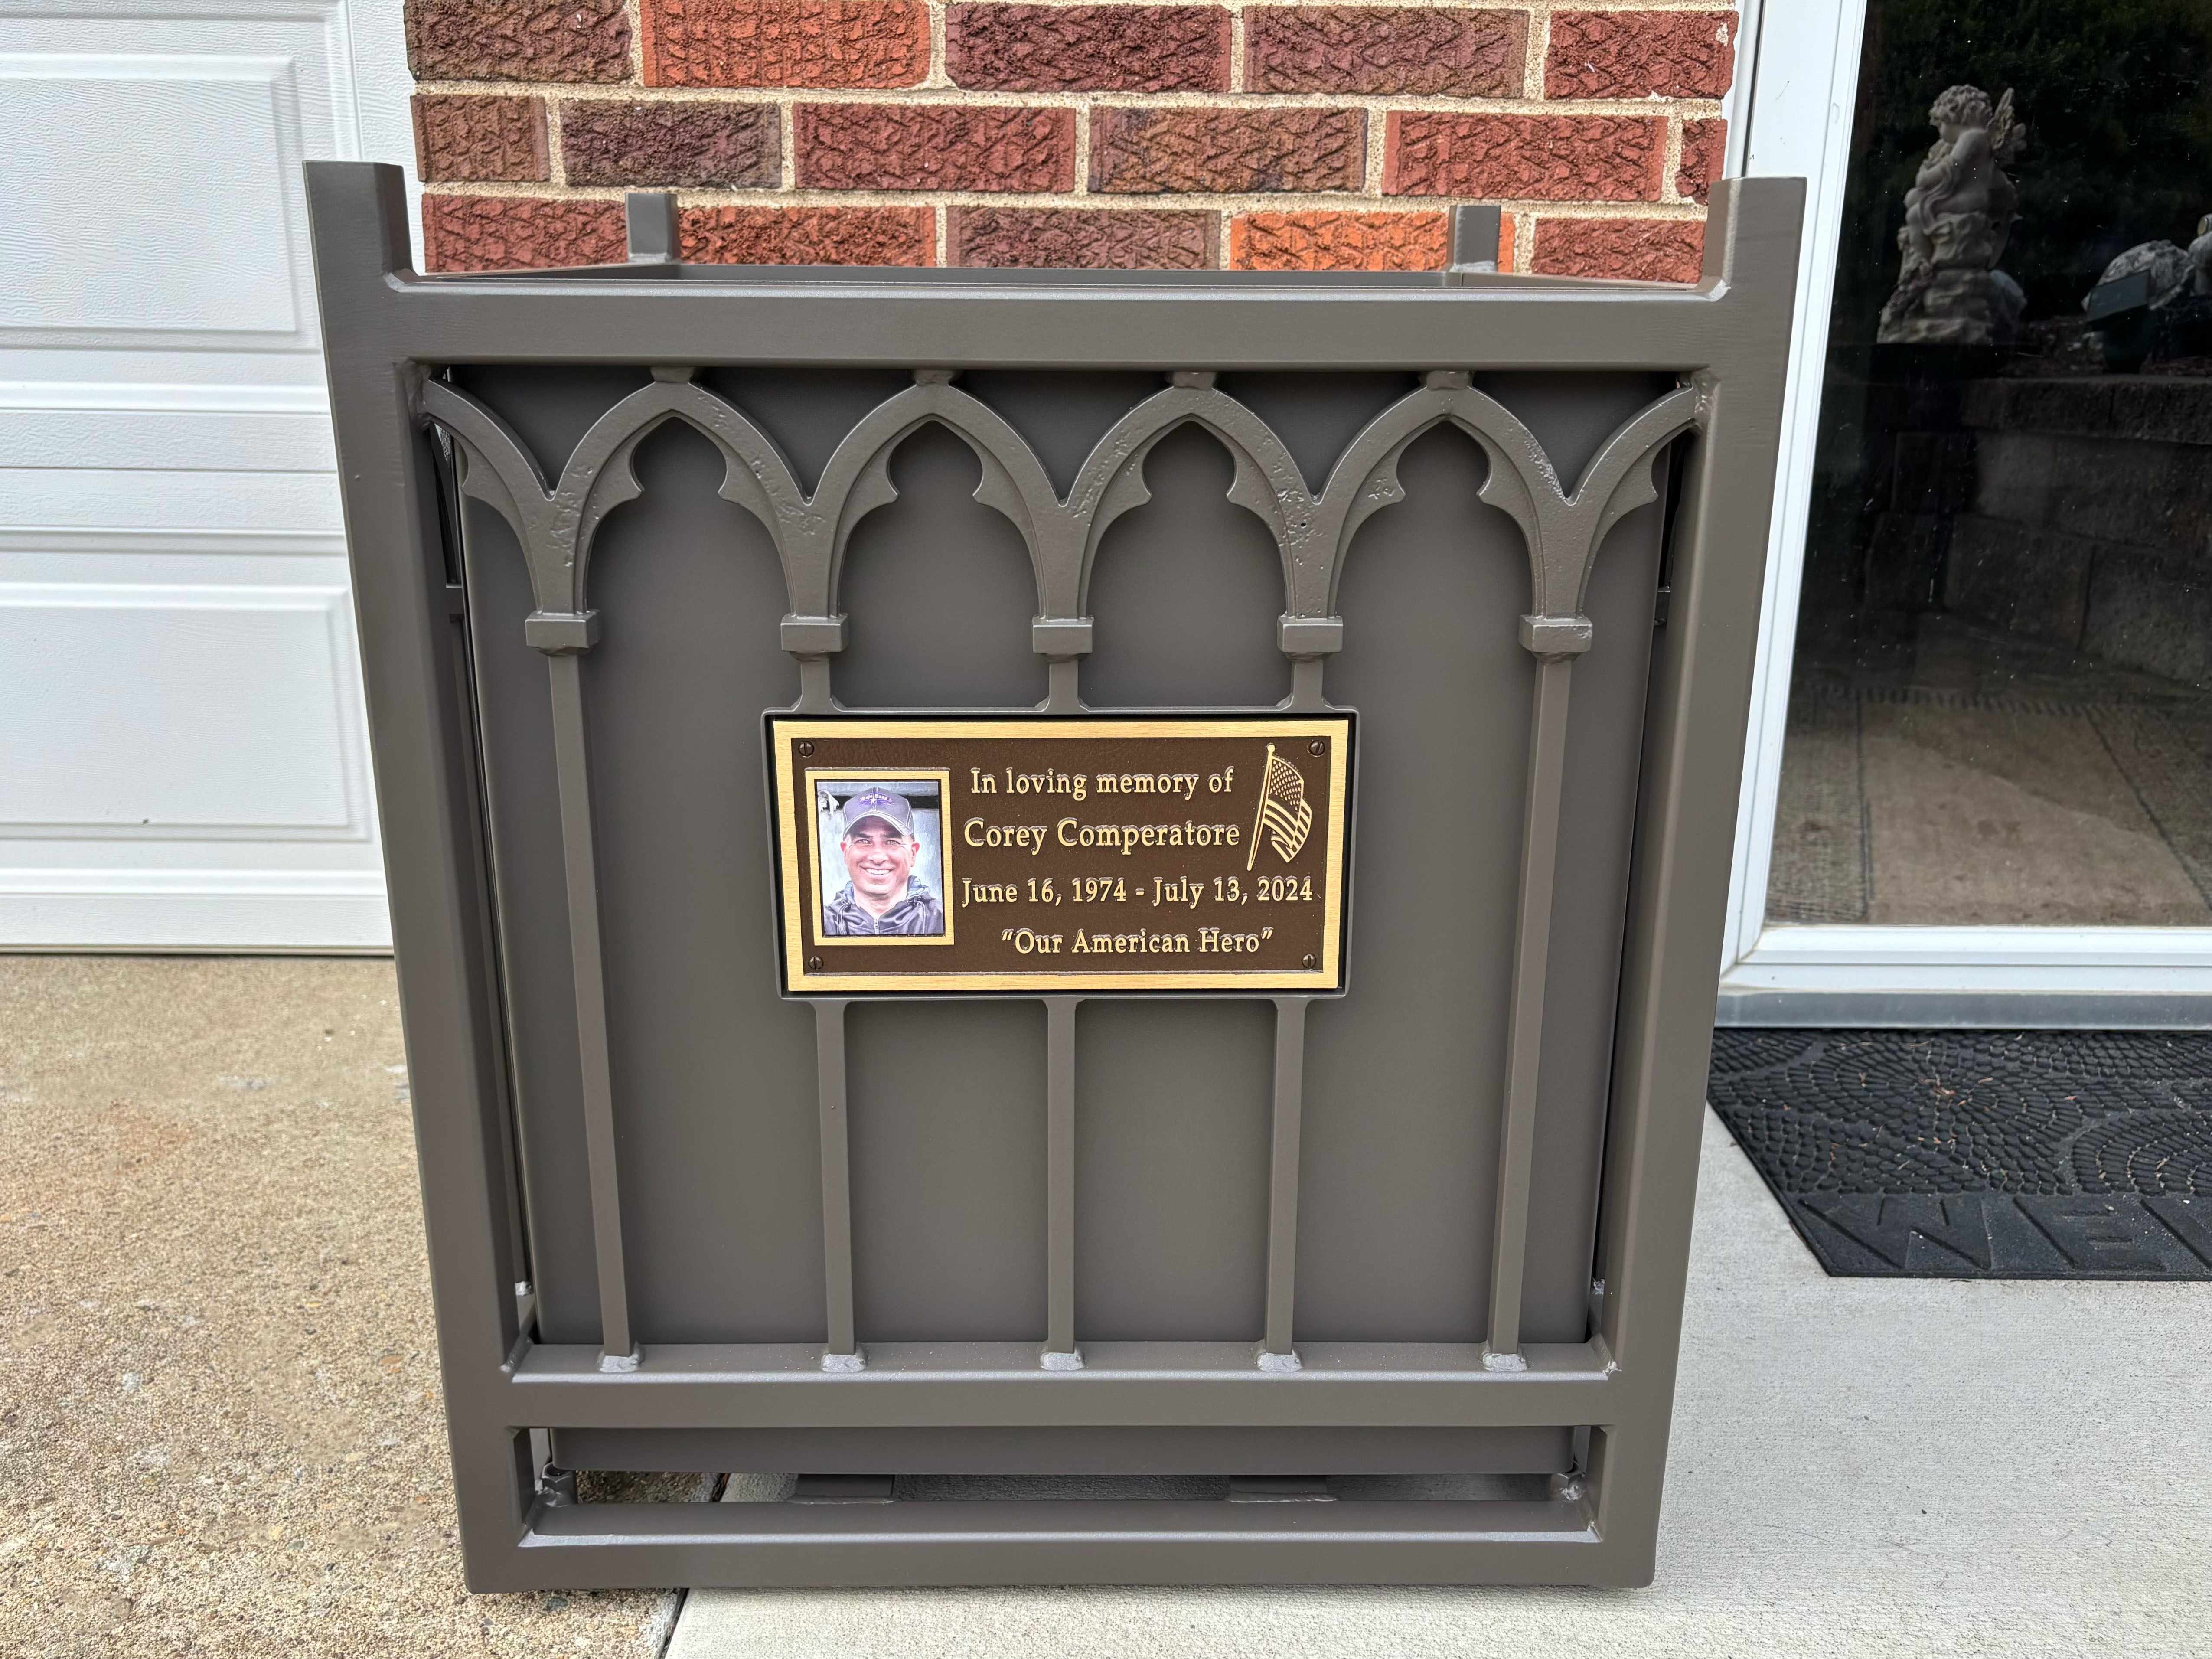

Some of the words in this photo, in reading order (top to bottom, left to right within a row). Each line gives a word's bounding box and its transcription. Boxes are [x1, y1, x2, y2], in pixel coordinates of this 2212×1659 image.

[971, 769, 997, 794] In
[1006, 768, 1087, 801] loving
[1096, 775, 1197, 801] memory
[1208, 768, 1234, 794] of
[964, 819, 1048, 856] Corey
[1057, 819, 1240, 856] Comperatore
[962, 879, 1018, 908] June
[1028, 879, 1062, 907] 16,
[1072, 878, 1127, 903] 1974
[1153, 878, 1204, 910] July
[1214, 878, 1247, 905] 13,
[1257, 878, 1313, 902] 2024
[1002, 930, 1063, 954] “Our
[1071, 929, 1191, 954] American
[1200, 929, 1273, 953] Hero”
